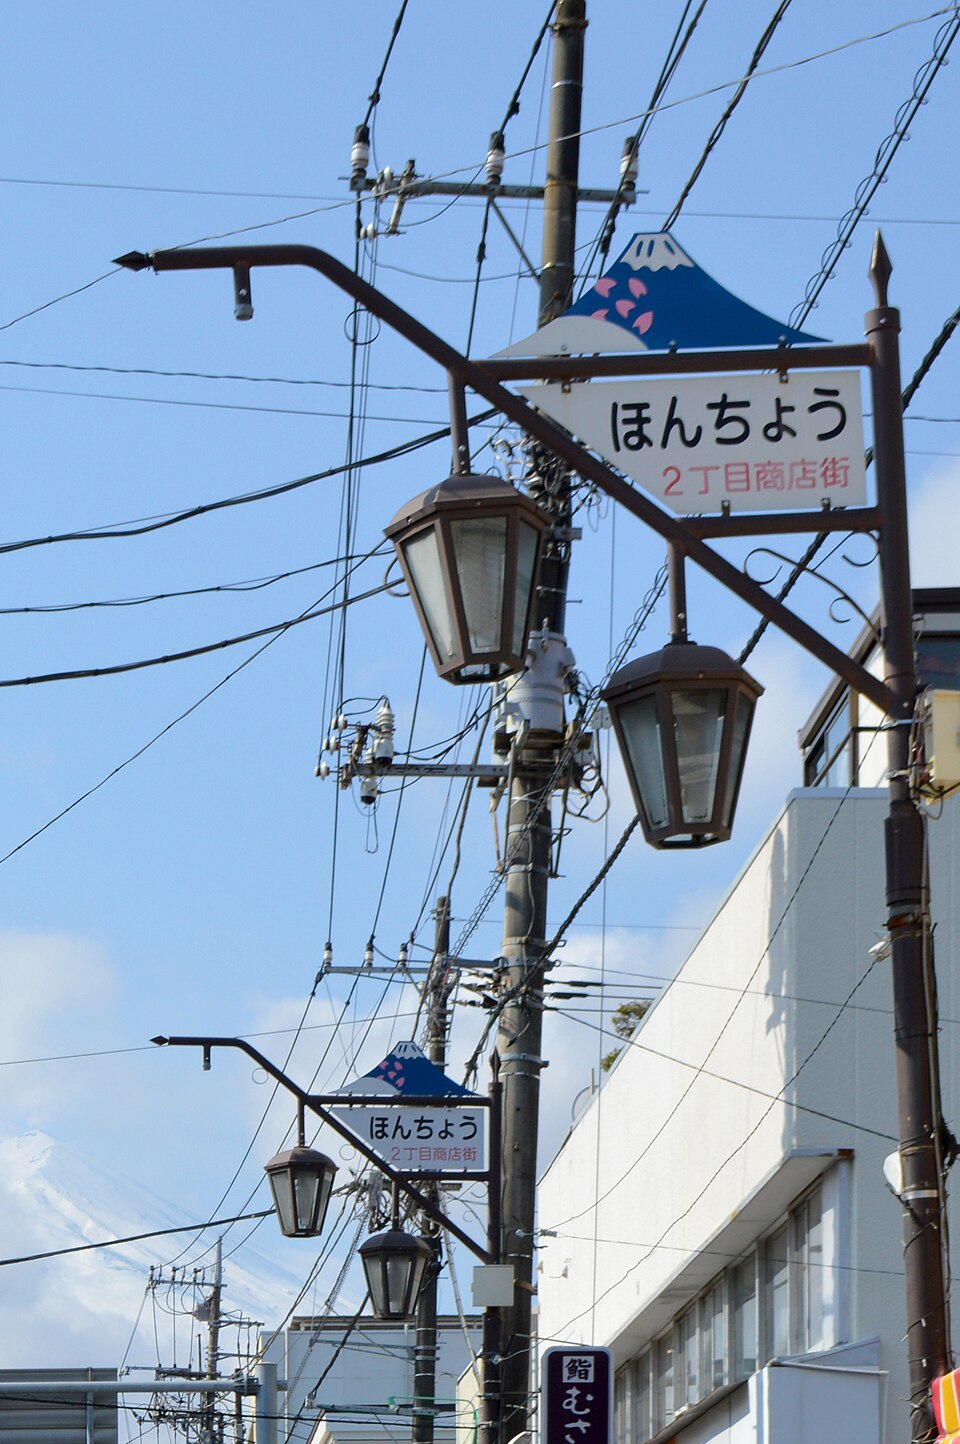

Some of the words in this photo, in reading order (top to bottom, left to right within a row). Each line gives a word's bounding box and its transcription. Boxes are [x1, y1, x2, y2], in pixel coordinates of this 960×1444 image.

[612, 388, 847, 452] ほんちょう
[662, 457, 849, 498] 2丁目商店街
[369, 1115, 478, 1140] ほんちょう
[391, 1147, 477, 1162] 2丁目商店街
